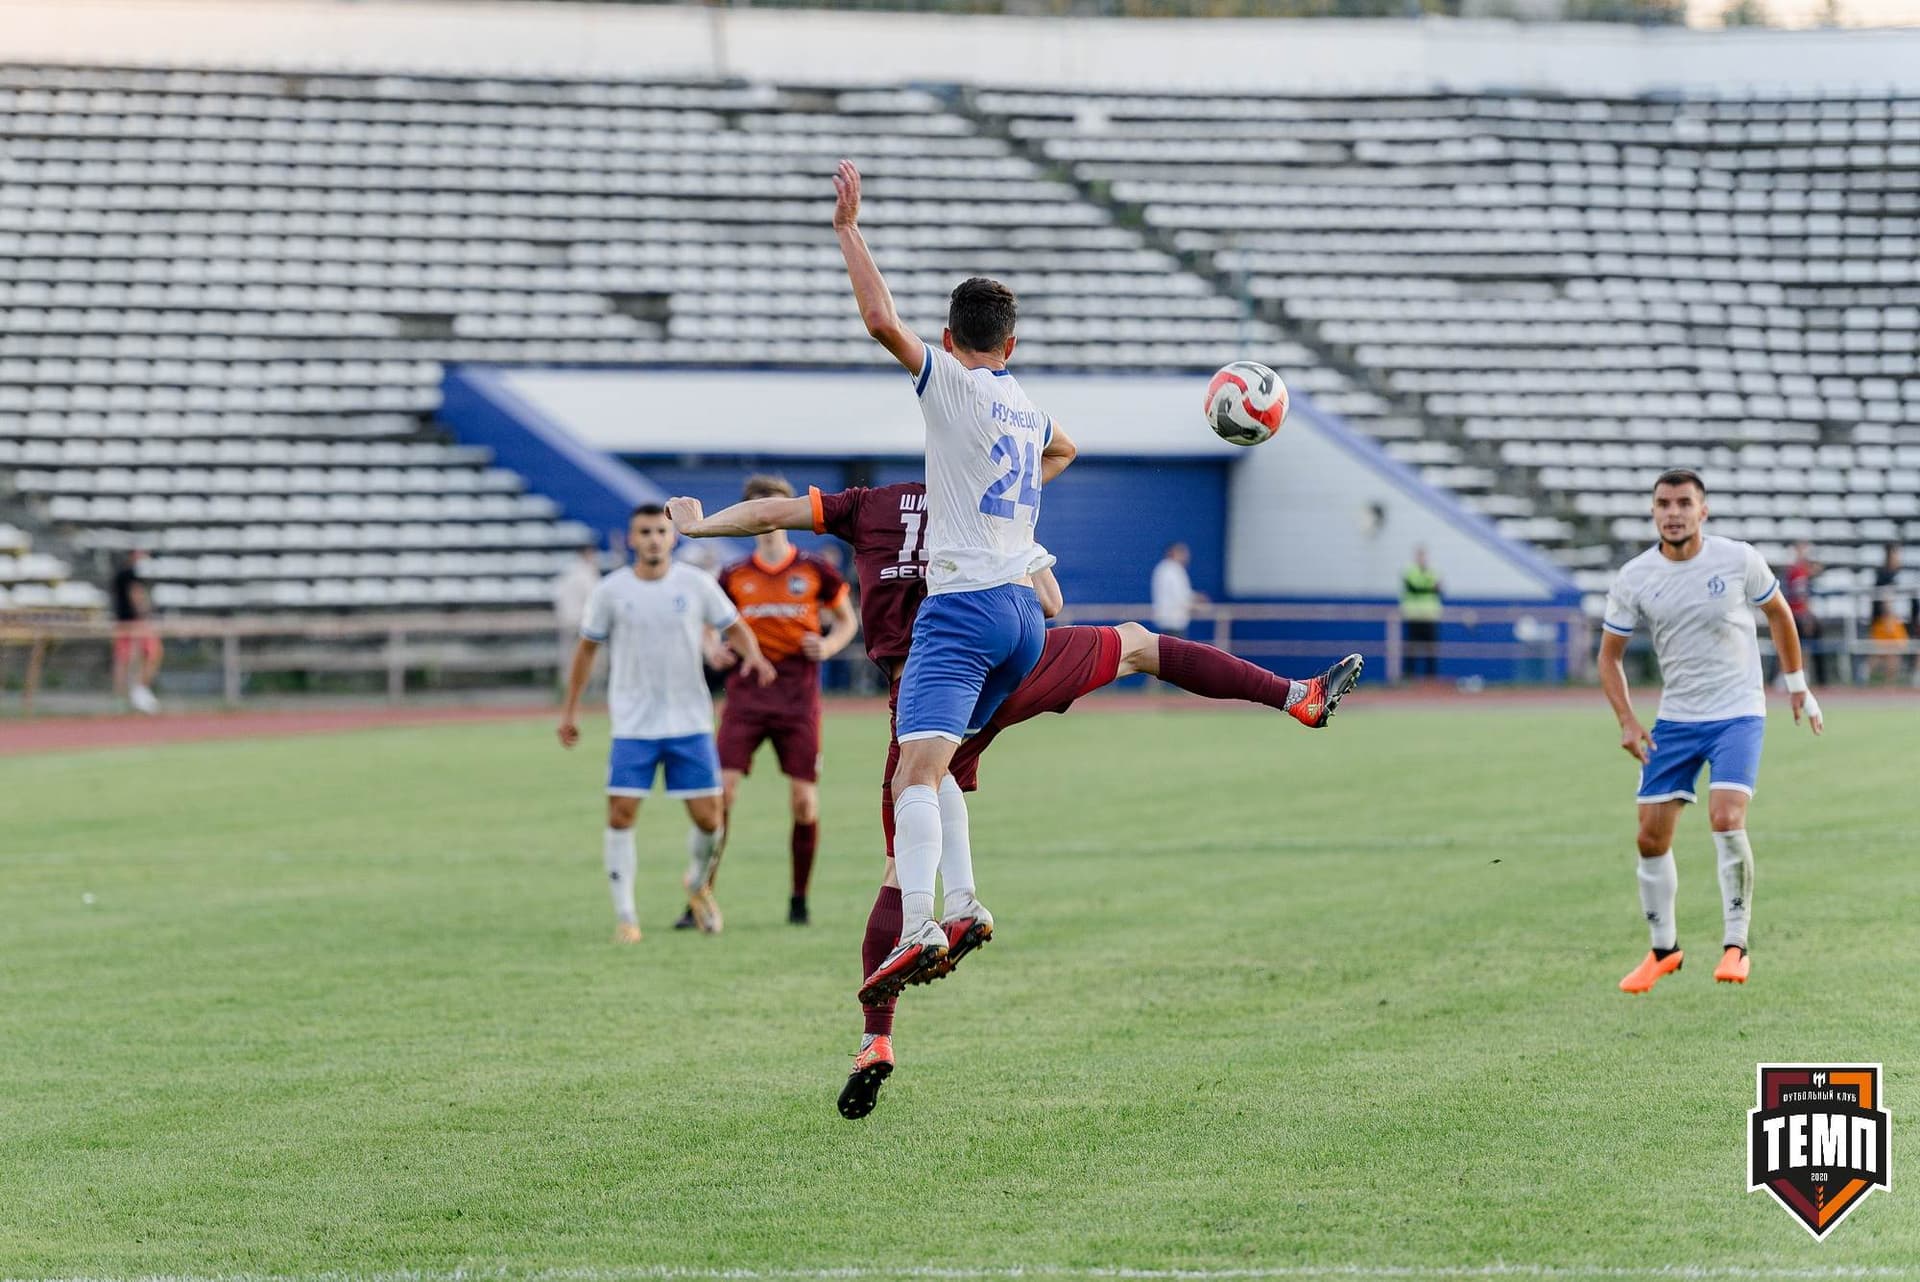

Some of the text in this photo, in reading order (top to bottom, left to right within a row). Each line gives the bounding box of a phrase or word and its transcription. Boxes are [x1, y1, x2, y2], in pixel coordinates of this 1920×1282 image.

[899, 494, 928, 511] ШИ
[979, 435, 1041, 526] 24
[898, 513, 929, 562] 1
